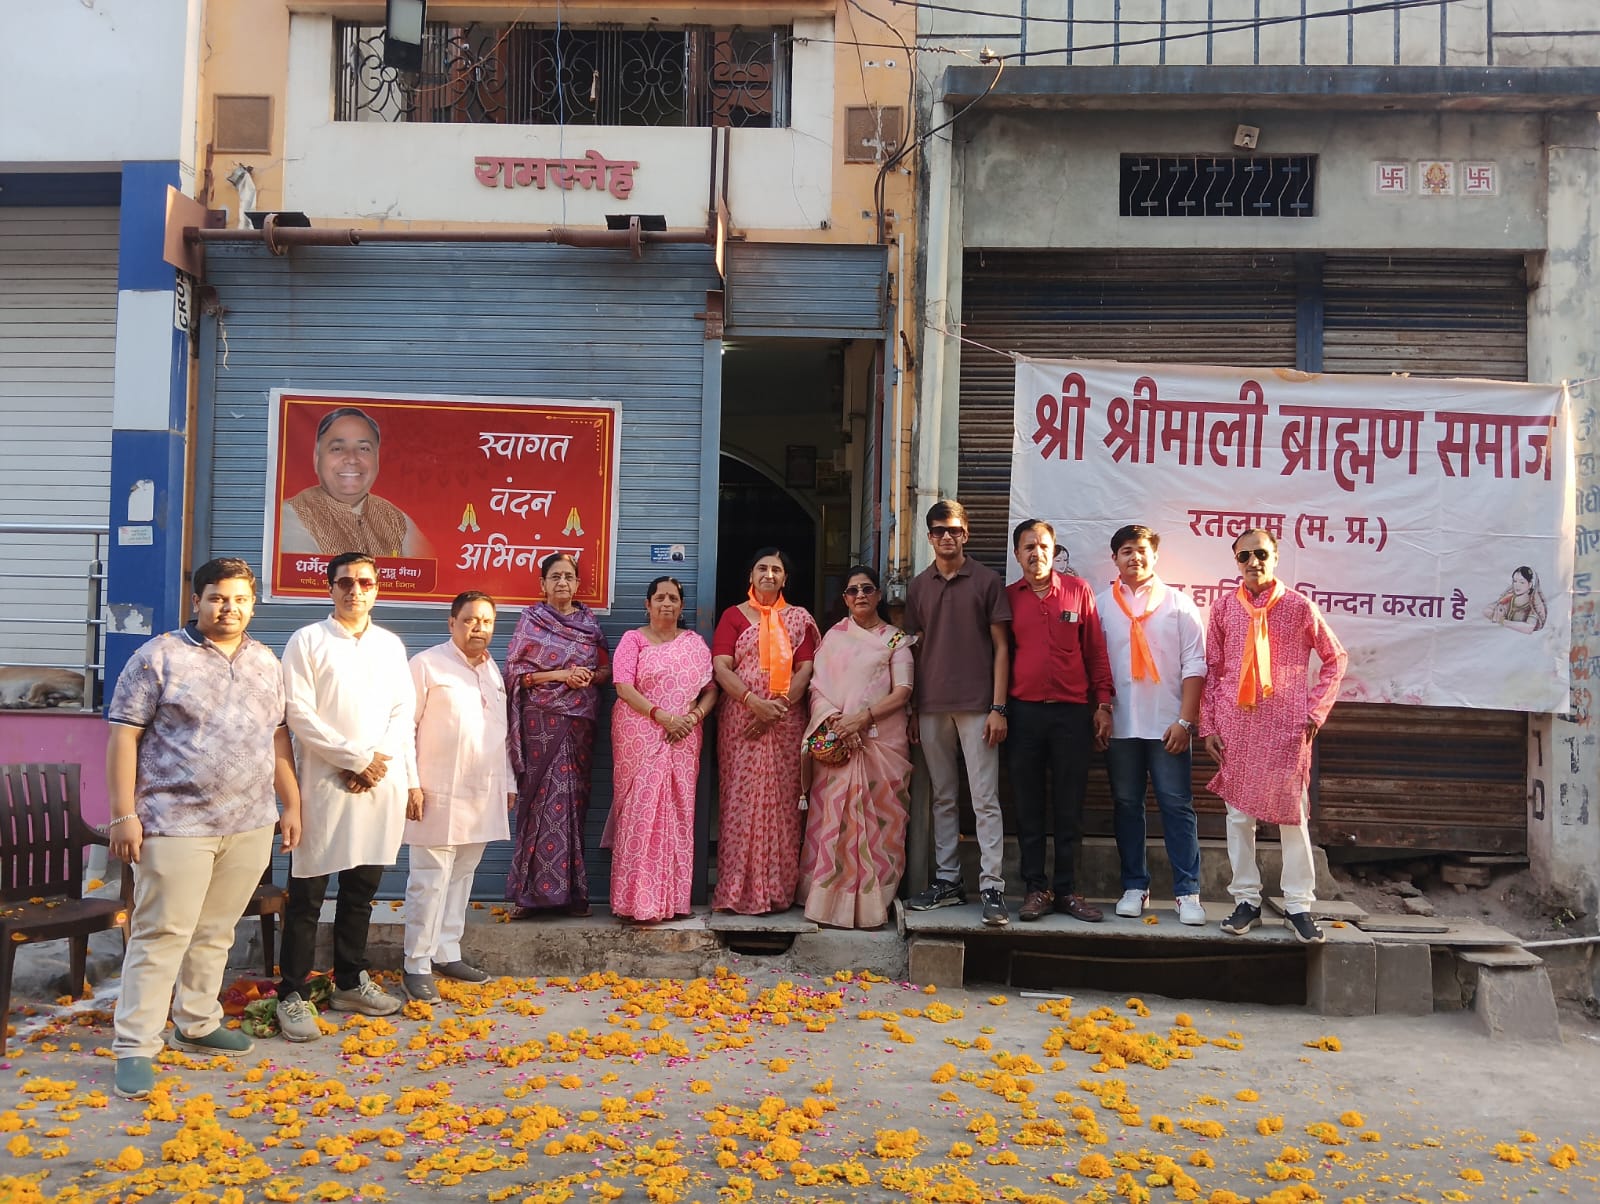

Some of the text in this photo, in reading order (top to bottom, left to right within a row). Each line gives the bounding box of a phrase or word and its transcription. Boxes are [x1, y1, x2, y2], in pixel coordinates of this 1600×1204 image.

[475, 150, 640, 200] रामस्नेह
[478, 431, 573, 464] स्वागत
[1032, 372, 1090, 461] श्री
[1102, 376, 1268, 469] श्रीमाली
[1279, 404, 1425, 491] ब्राह्मण
[1435, 411, 1557, 481] समाज
[489, 477, 557, 520] वंदन
[1187, 509, 1388, 552] रतलाम (म. प्र.)
[1381, 594, 1445, 618] करता
[1450, 588, 1468, 620] है
